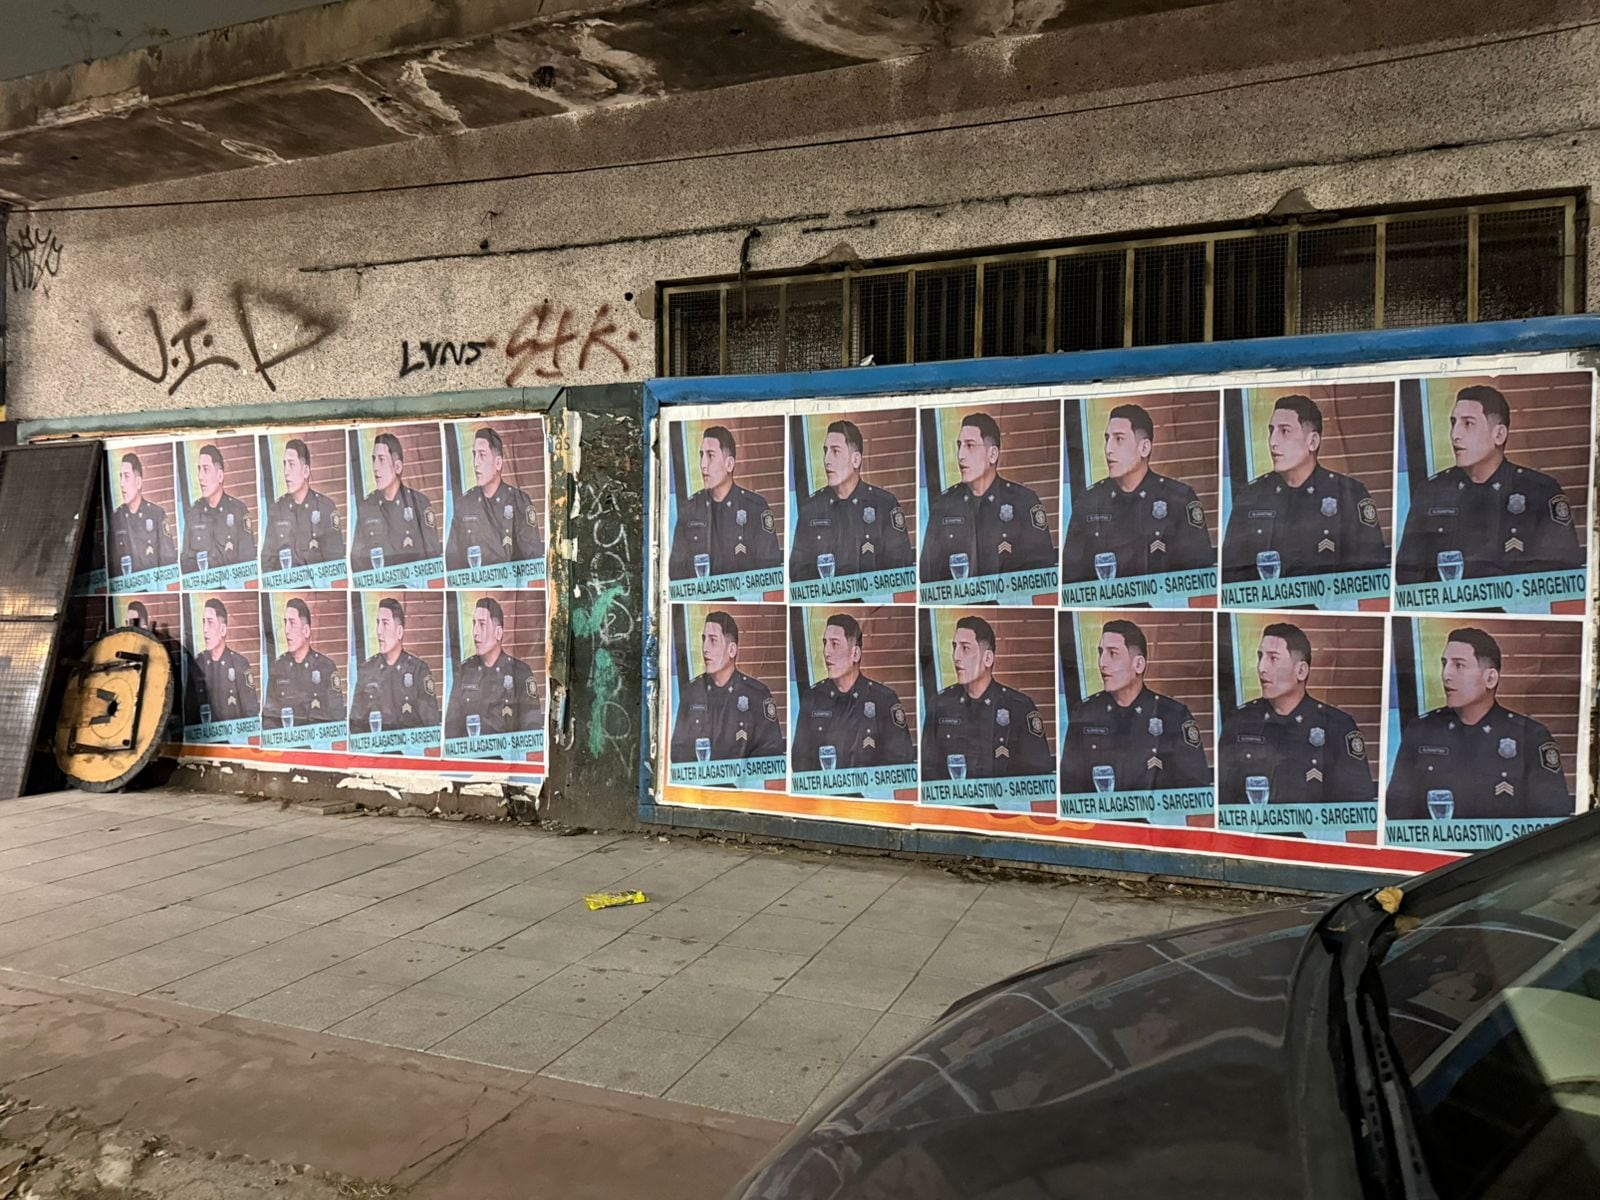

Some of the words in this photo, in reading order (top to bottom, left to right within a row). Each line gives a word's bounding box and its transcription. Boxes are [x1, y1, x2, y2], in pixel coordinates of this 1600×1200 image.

[375, 567, 410, 584] ALAGASTINO
[414, 561, 444, 578] SARGENTO
[471, 566, 508, 584] ALAGASTINO
[512, 561, 545, 578] SARGENTO
[669, 583, 696, 598] WALTER
[697, 577, 741, 595] ALAGASTINO
[746, 570, 784, 589] SARGENTO
[790, 585, 820, 601] WALTER
[821, 577, 869, 598] ALAGASTINO
[874, 570, 916, 590] SARGENTO
[920, 585, 953, 603] WALTER
[954, 578, 1005, 598] ALAGASTINO
[1011, 571, 1058, 592] SARGENTO
[1061, 586, 1097, 605] WALTER
[1099, 578, 1157, 601] ALAGASTINO
[1165, 572, 1217, 593] SARGENTO
[1221, 586, 1259, 605] WALTER
[1261, 580, 1325, 601] ALAGASTINO
[1334, 573, 1390, 595] SARGENTO
[1396, 588, 1440, 608] WALTER
[1442, 581, 1513, 604] ALAGASTINO
[1522, 574, 1586, 598] SARGENTO
[372, 733, 407, 748] ALAGASTINO
[410, 729, 441, 744] SARGENTO
[469, 737, 507, 753] ALAGASTINO
[511, 733, 544, 749] SARGENTO
[671, 767, 697, 781] WALTER
[698, 763, 741, 779] ALAGASTINO
[747, 759, 786, 776] SARGENTO
[792, 775, 822, 791] WALTER
[823, 772, 869, 789] ALAGASTINO
[874, 768, 918, 786] SARGENTO
[952, 782, 1003, 799] ALAGASTINO
[1009, 779, 1056, 797] SARGENTO
[1061, 798, 1097, 815] WALTER
[1098, 795, 1156, 813] ALAGASTINO
[1162, 791, 1214, 811] SARGENTO
[1218, 809, 1248, 826] ALTER
[1250, 808, 1313, 826] ALAGASTINO
[1321, 807, 1377, 825] SARGENTO
[1386, 825, 1430, 843] WALTER
[1432, 824, 1503, 843] ALAGASTINO
